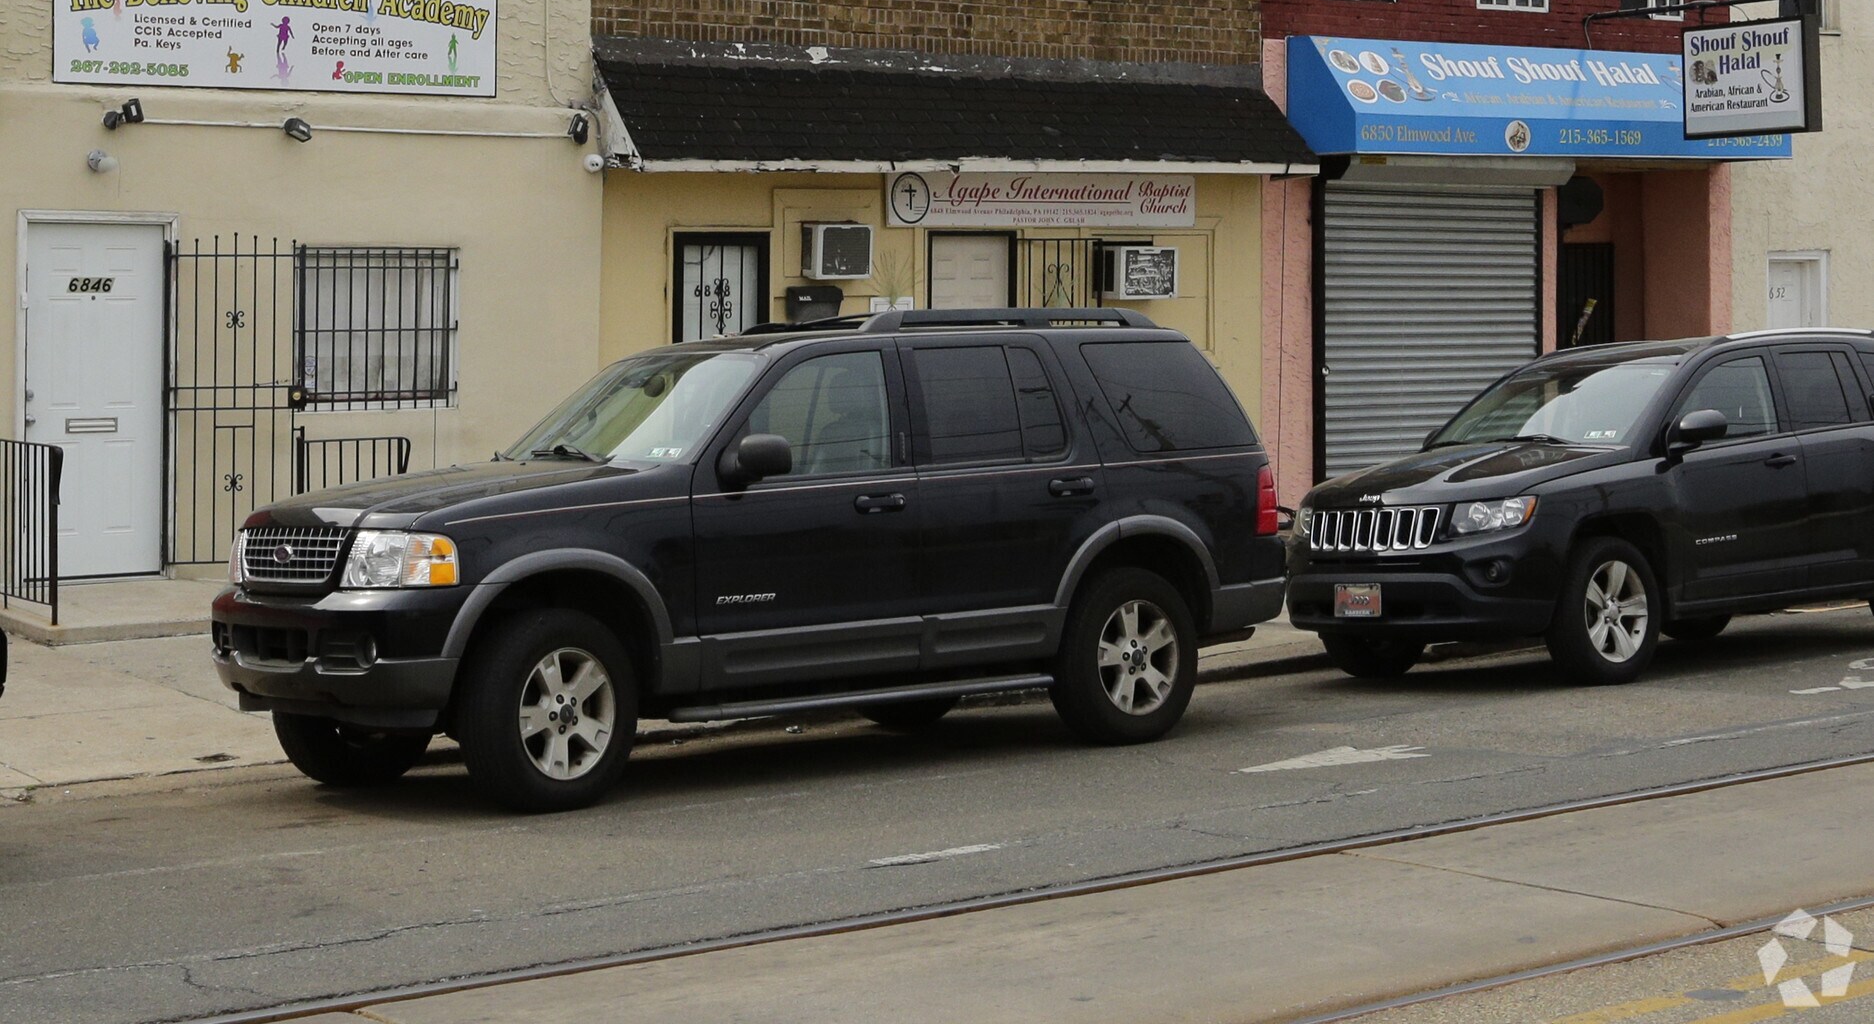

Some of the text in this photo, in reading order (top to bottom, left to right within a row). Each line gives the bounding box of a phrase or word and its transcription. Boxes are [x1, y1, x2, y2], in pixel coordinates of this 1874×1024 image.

[134, 13, 252, 28] Licensed & Certified
[134, 26, 223, 40] CCIS Accepted
[312, 23, 381, 36] Open 7 days
[134, 38, 182, 51] Pa. Keys
[312, 35, 414, 50] Accepting all ages
[1690, 27, 1790, 56] Shouf Shouf
[311, 46, 429, 60] Before and After care
[70, 59, 190, 77] 267-292-5085
[1420, 52, 1660, 87] Shouf Shouf Halal
[1719, 52, 1761, 75] Halal
[344, 71, 481, 88] OPEN ENROLLMENT
[1695, 83, 1763, 99] Arabian, African &
[1690, 97, 1769, 113] American Restaurant
[1361, 124, 1478, 143] 6850 Elmwood Ave.
[1559, 128, 1642, 145] 215-365-1569
[933, 175, 1133, 207] Agape International
[1138, 181, 1191, 204] Baptist
[1140, 198, 1187, 214] Church
[68, 277, 113, 292] 6846
[1695, 534, 1738, 545] COMPASS
[715, 592, 777, 605] EXPLORER
